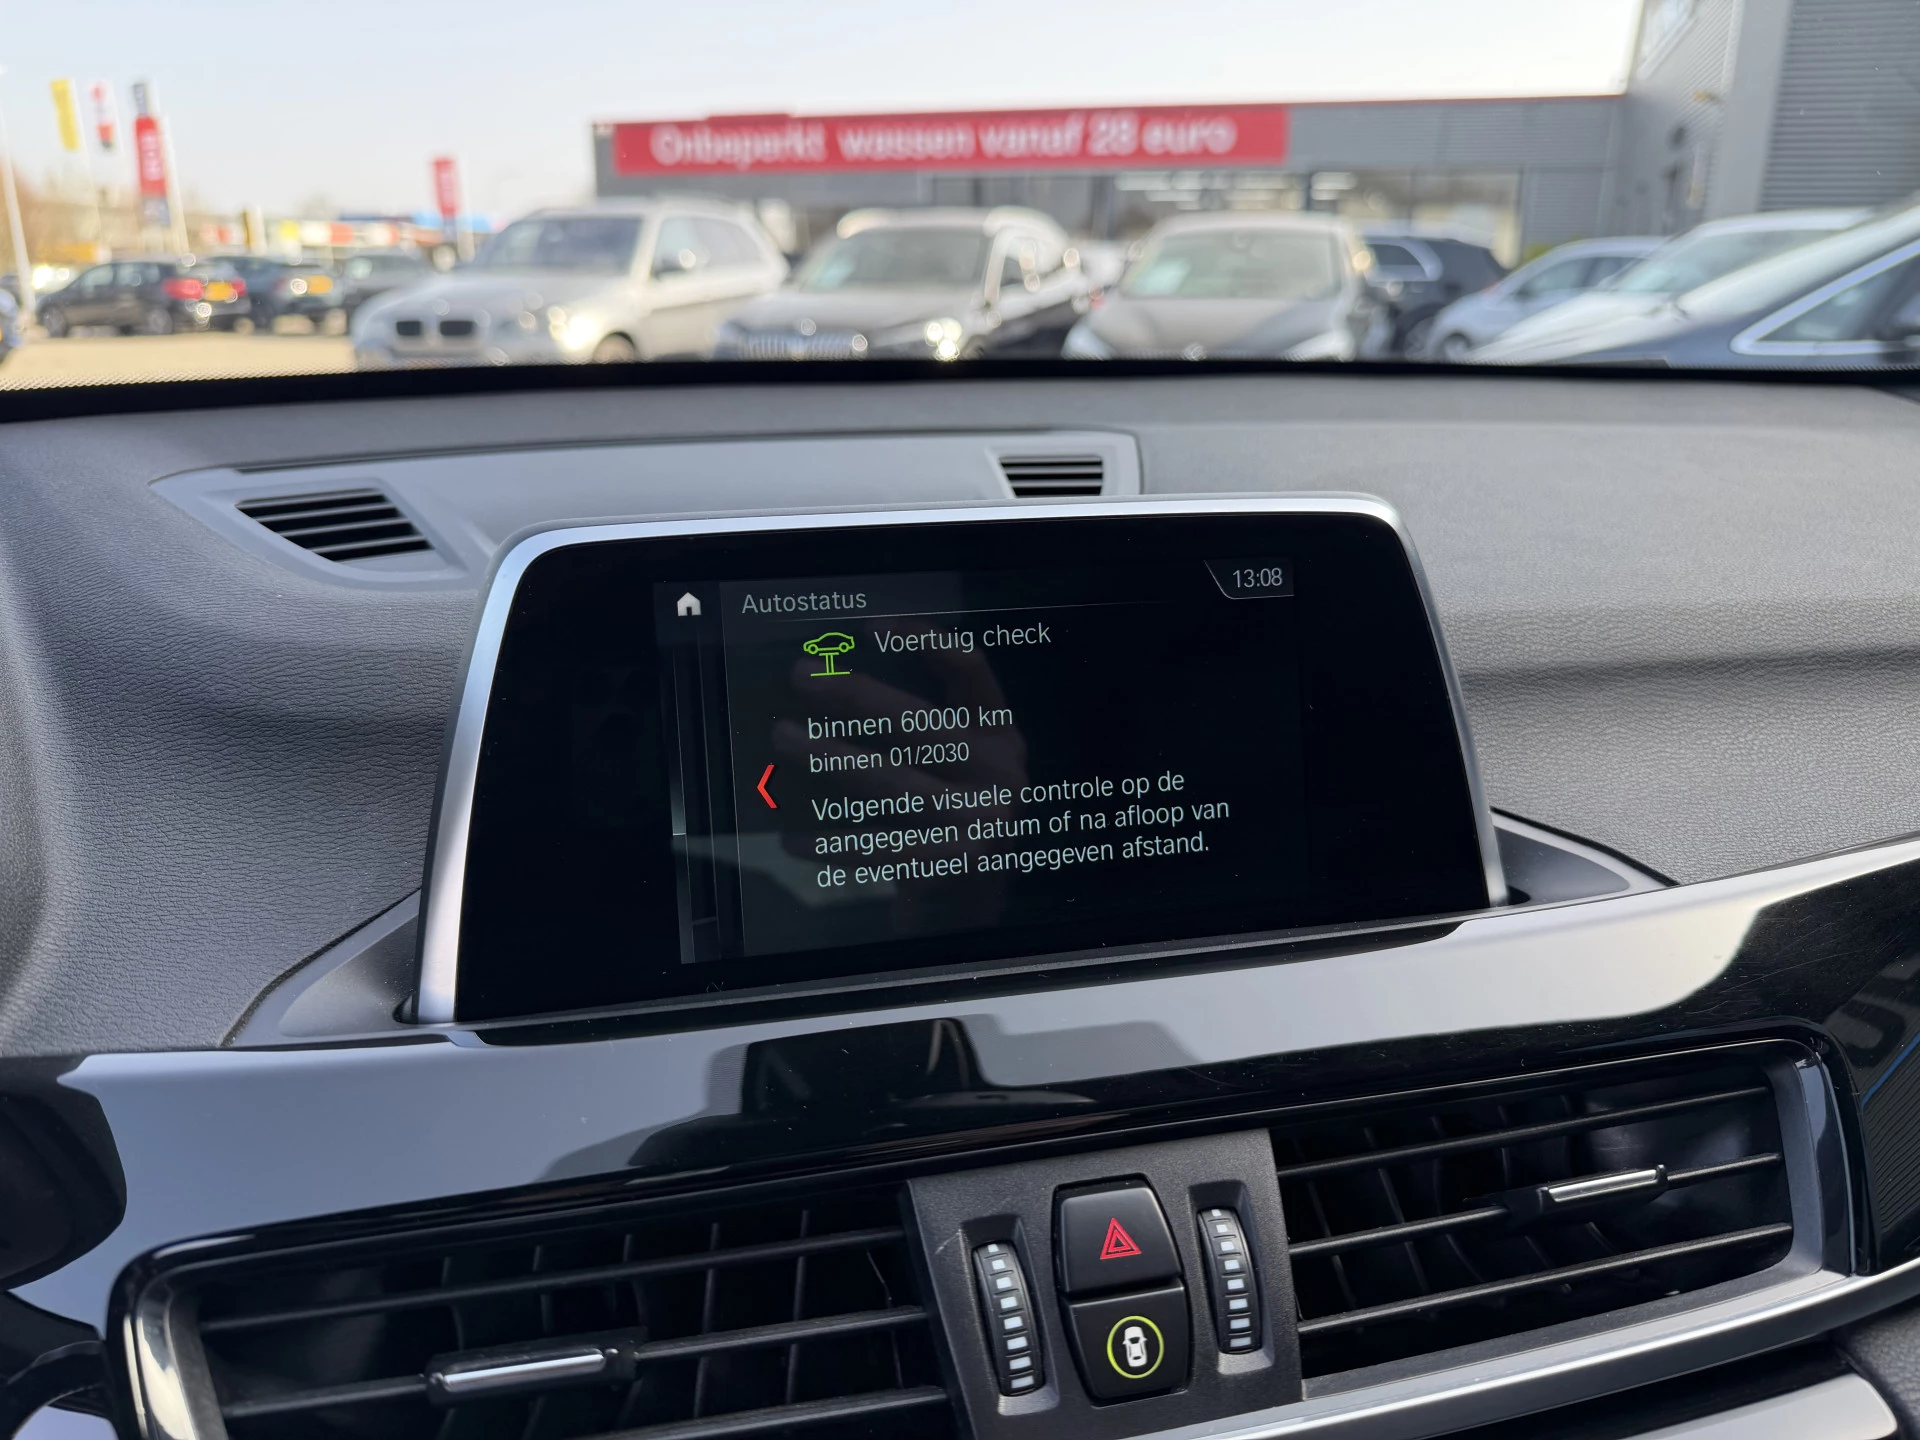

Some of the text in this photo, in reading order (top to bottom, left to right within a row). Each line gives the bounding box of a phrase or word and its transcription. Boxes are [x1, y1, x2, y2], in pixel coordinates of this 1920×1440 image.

[1141, 113, 1238, 155] euro
[1232, 567, 1282, 588] 13:08
[741, 591, 867, 614] Autostatus
[874, 622, 1052, 654] Voertuig check
[807, 705, 1013, 740] binnen 60000 km
[809, 741, 970, 773] binnen 01/2030
[811, 770, 1185, 823] Volgende visuele controle op de
[815, 800, 1230, 855] aangegeven datum of na afloop van
[816, 830, 1209, 888] de eventueel aangegeven afstand.
